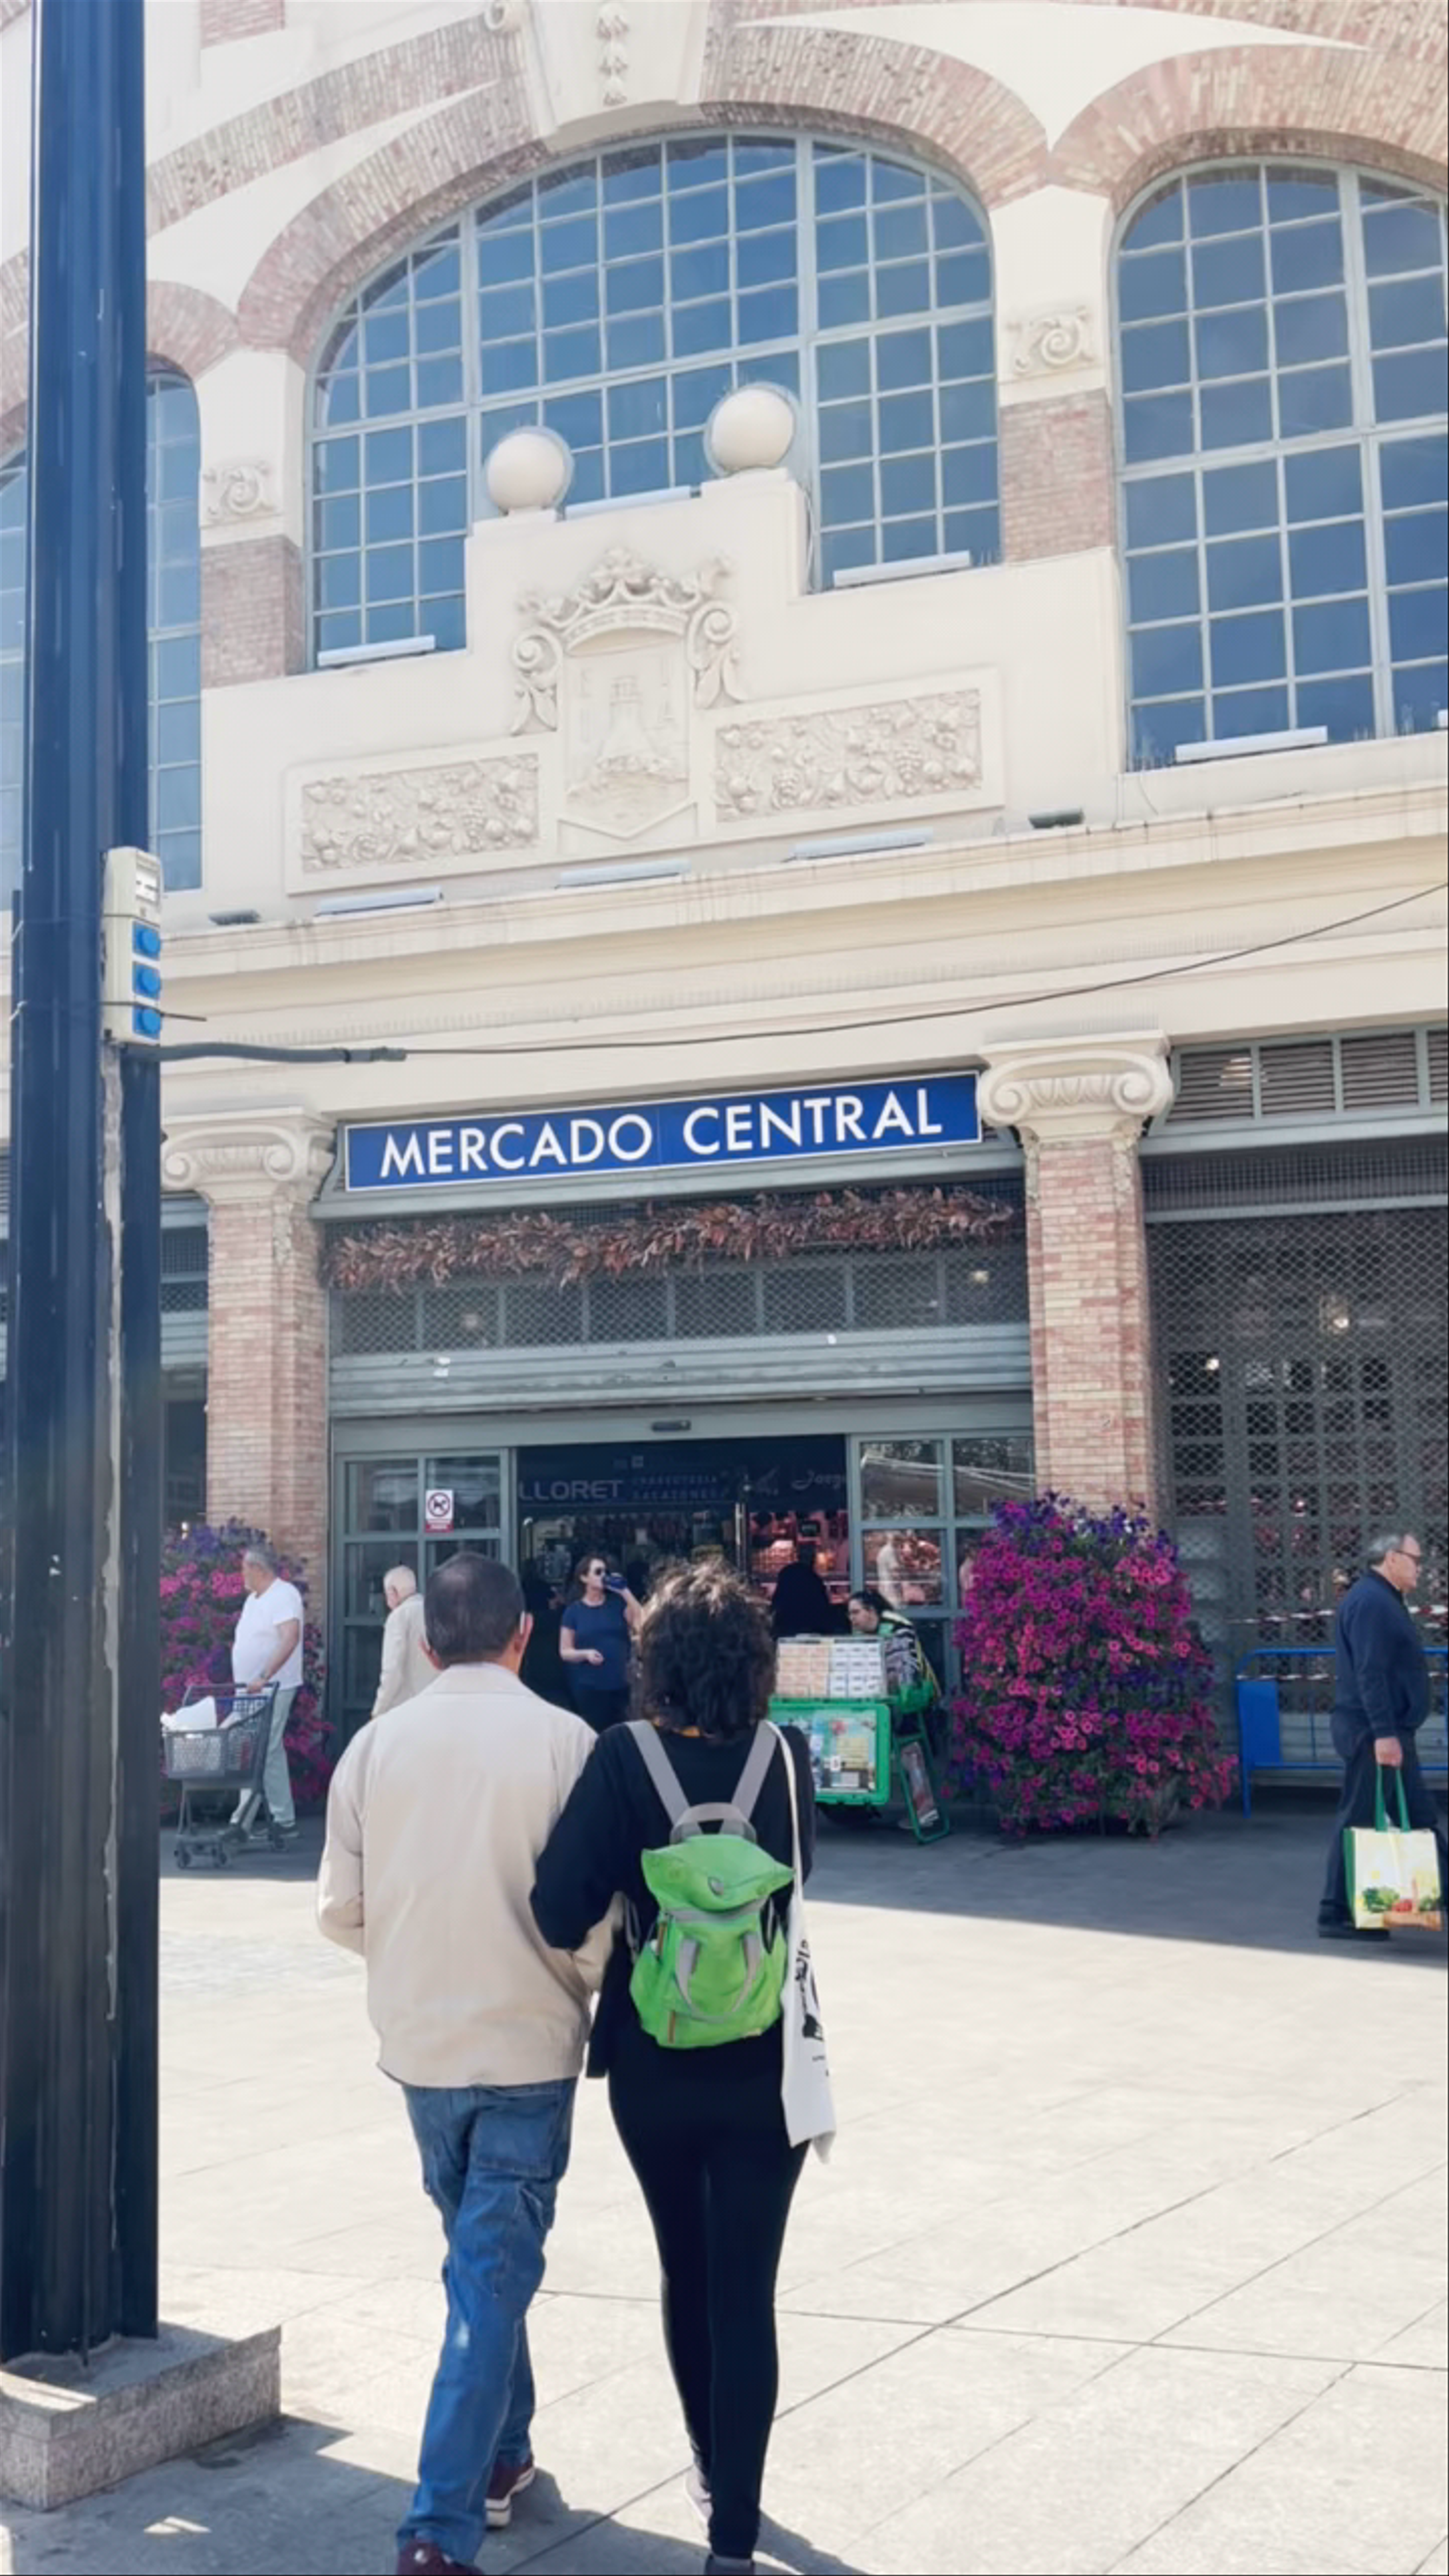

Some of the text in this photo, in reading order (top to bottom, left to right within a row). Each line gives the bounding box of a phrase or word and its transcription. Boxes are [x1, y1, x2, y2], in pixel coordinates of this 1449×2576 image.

[379, 1088, 943, 1178] MERCADO CENTRAL
[518, 1479, 624, 1501] LLORET
